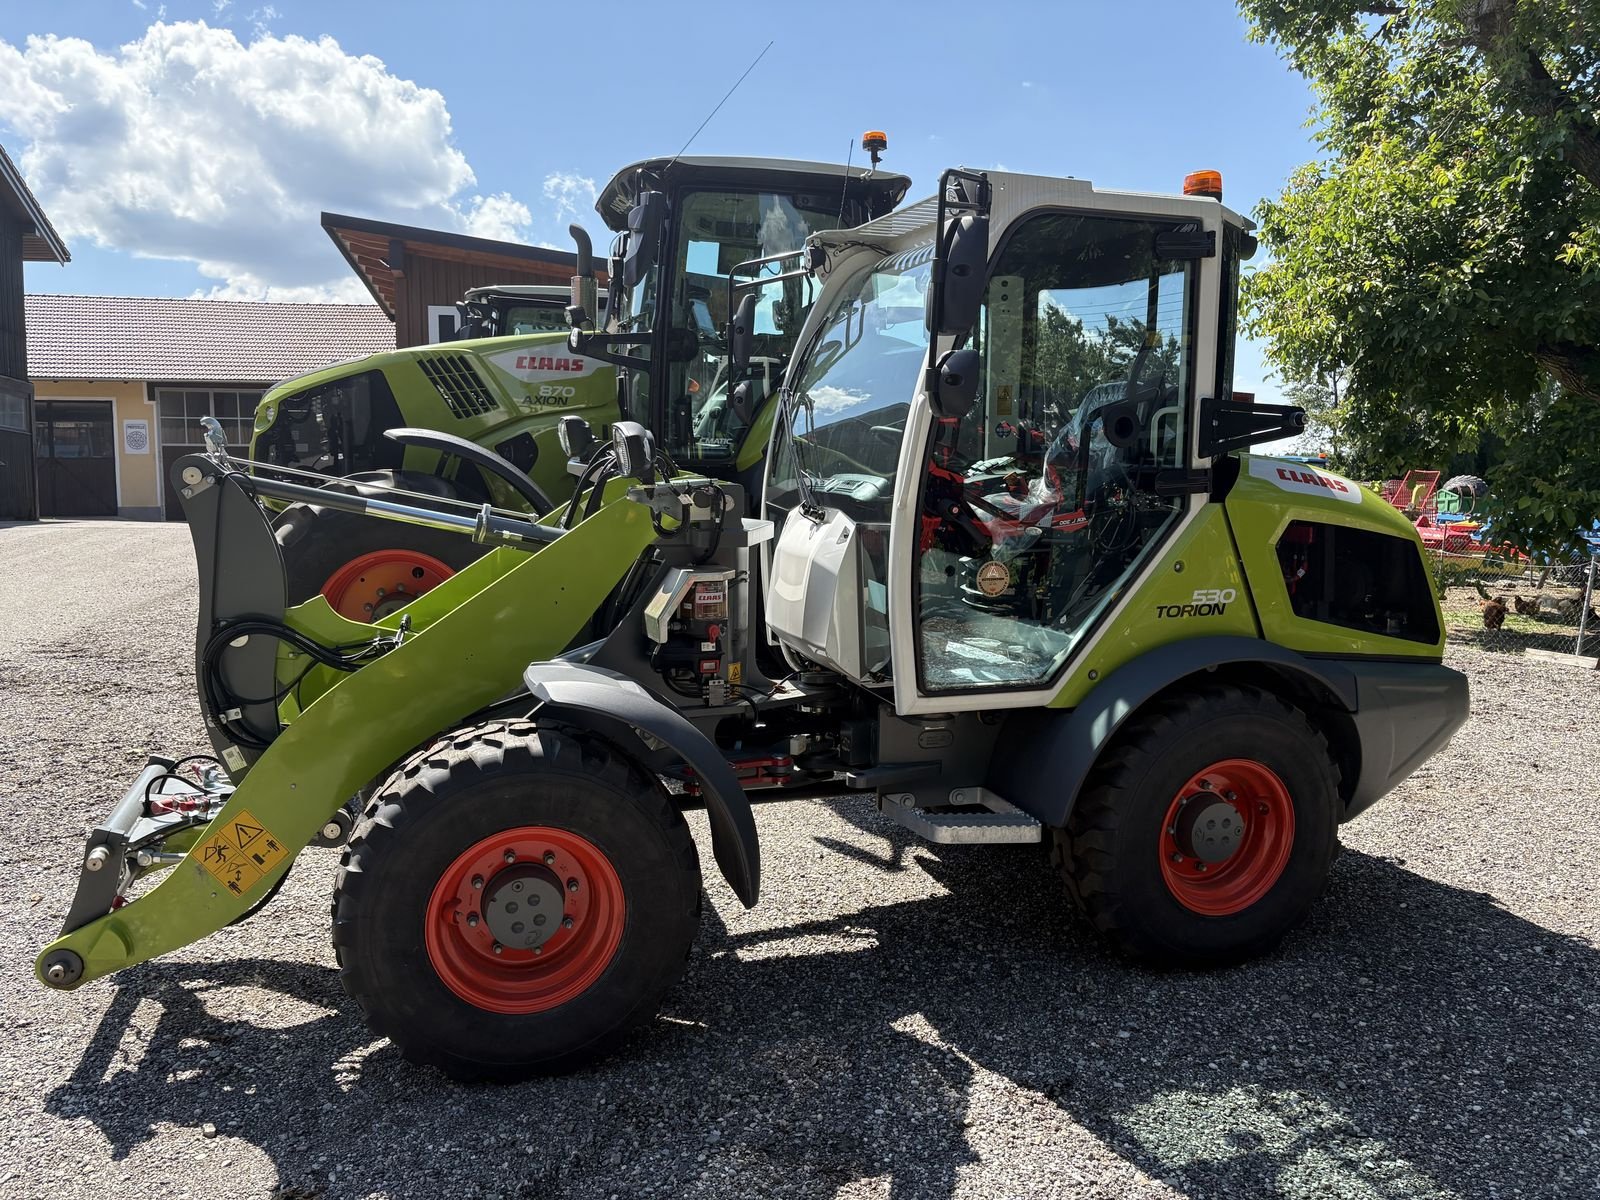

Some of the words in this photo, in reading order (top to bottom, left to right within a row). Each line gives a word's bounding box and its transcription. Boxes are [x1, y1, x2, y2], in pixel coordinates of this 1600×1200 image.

[516, 356, 585, 371] CLAAS
[539, 386, 576, 397] 870
[522, 396, 569, 406] AXION
[700, 437, 733, 445] CMATIC
[1276, 468, 1349, 493] CLAAS
[1191, 588, 1237, 605] 530
[1156, 603, 1227, 619] TORION
